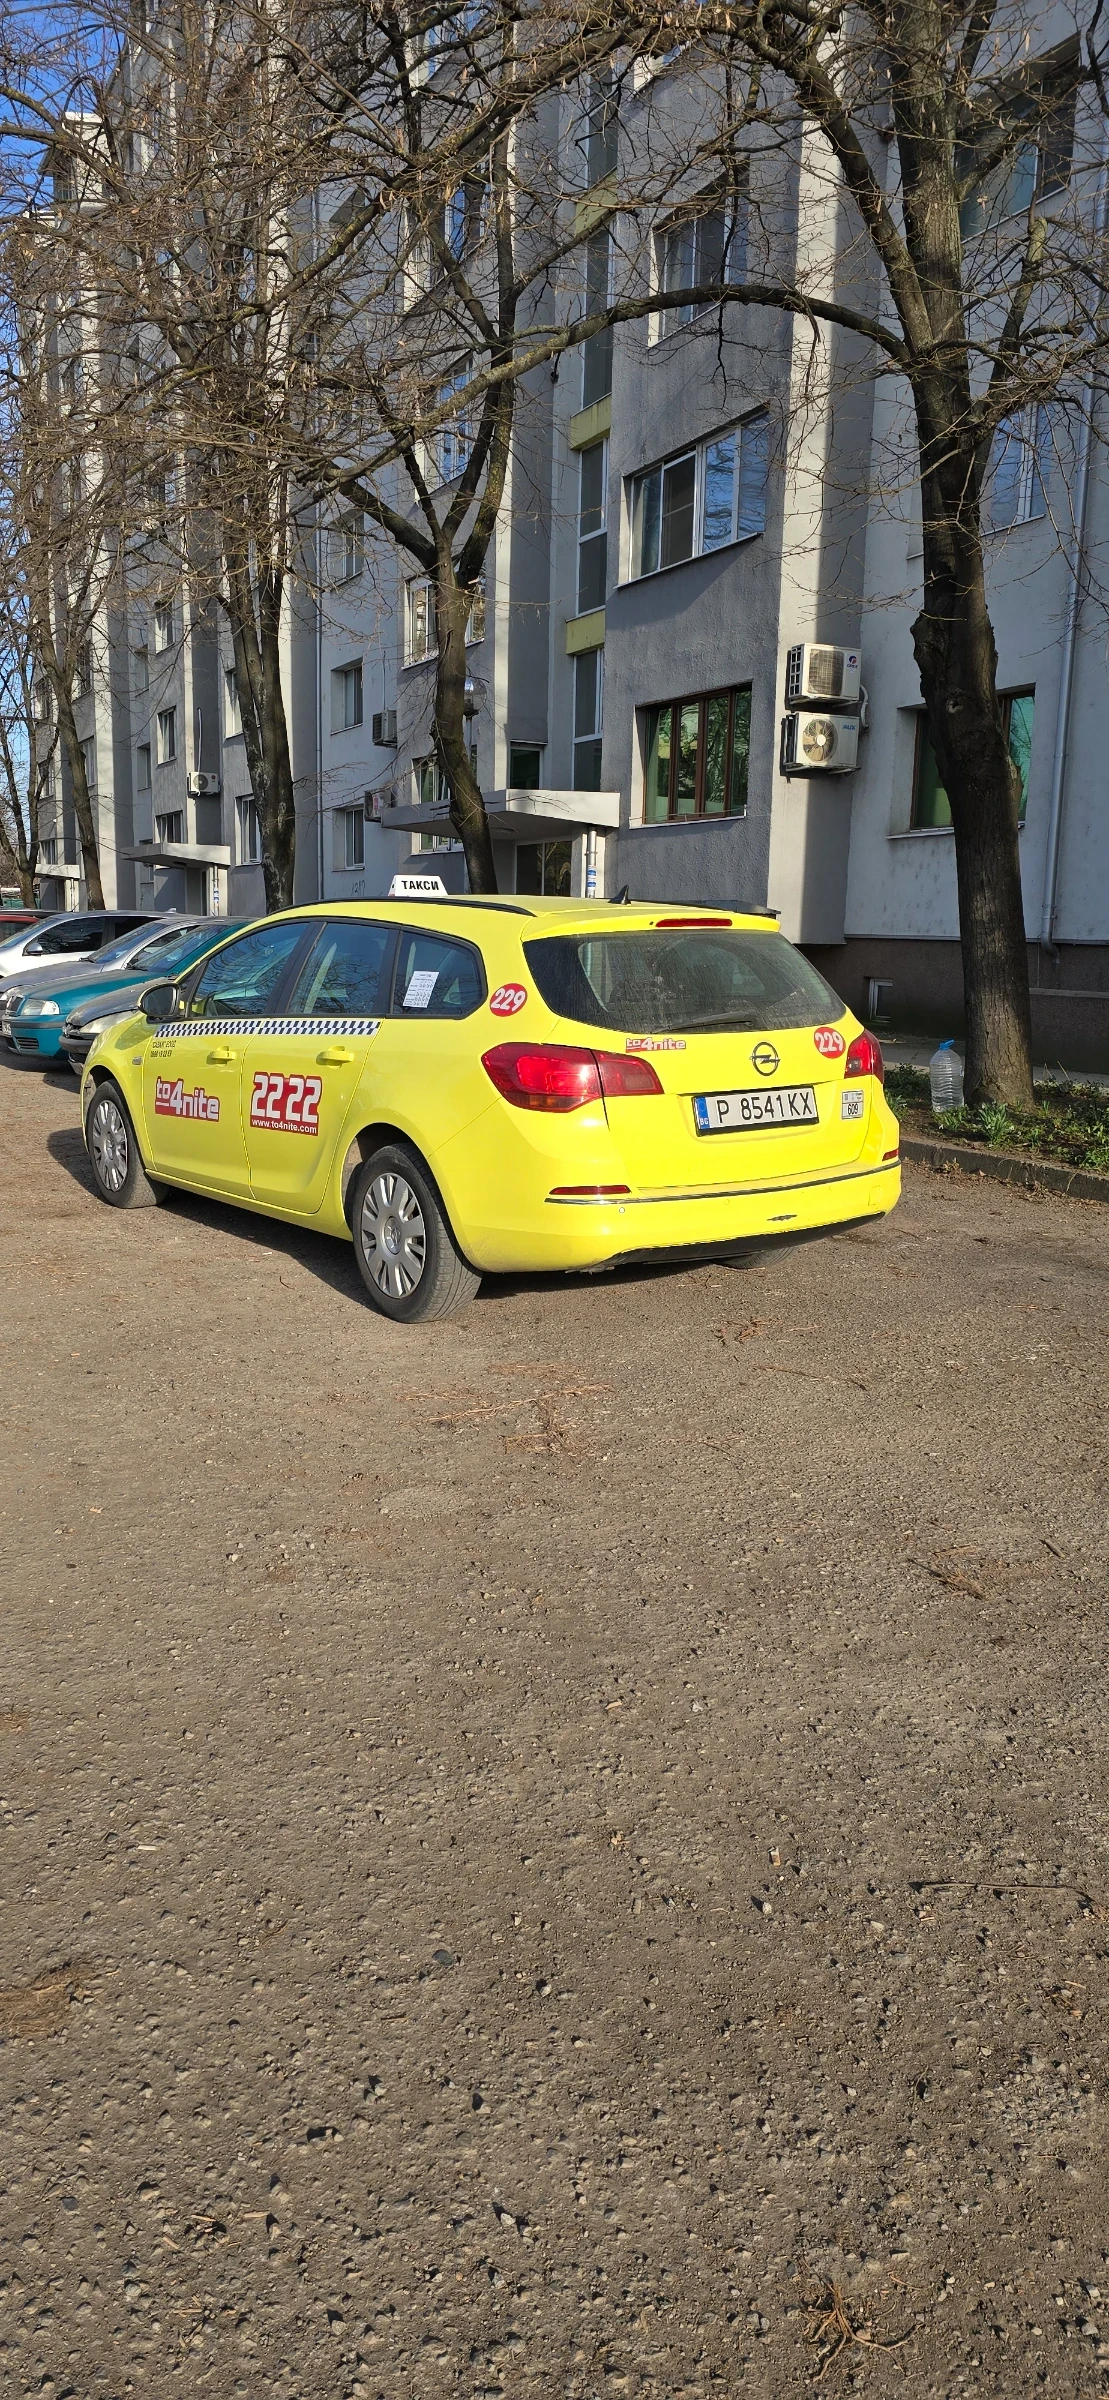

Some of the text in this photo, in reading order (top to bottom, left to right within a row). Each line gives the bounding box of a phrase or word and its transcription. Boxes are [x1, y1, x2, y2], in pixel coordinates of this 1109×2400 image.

[401, 880, 440, 891] ТАКСИ
[491, 987, 526, 1012] 229
[626, 1037, 686, 1050] to4nite
[815, 1031, 844, 1052] 229
[156, 1078, 219, 1120] to4nite
[847, 1103, 859, 1115] 609
[251, 1119, 317, 1134] www.to4nite.com
[700, 1117, 709, 1126] BG
